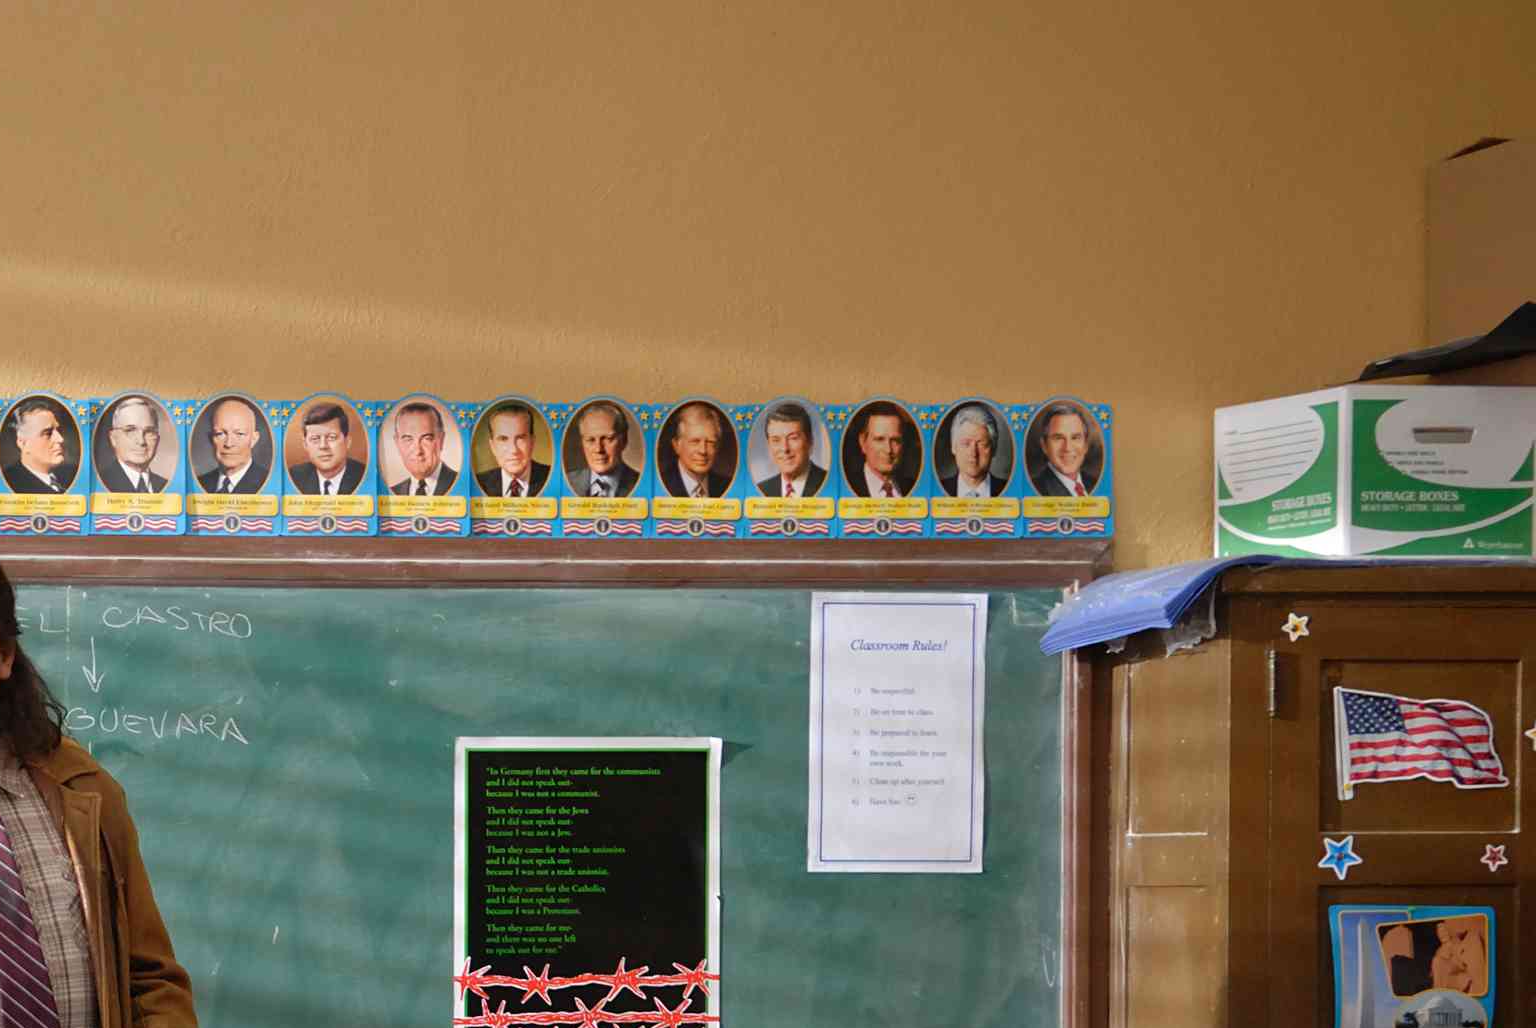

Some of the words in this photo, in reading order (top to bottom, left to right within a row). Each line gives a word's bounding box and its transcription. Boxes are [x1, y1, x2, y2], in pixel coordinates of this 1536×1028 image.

[1360, 491, 1416, 502] STORAGE
[1418, 491, 1459, 502] BOXES
[102, 605, 252, 639] CASTRO
[850, 639, 910, 651] Classroom
[912, 639, 948, 651] Rules!
